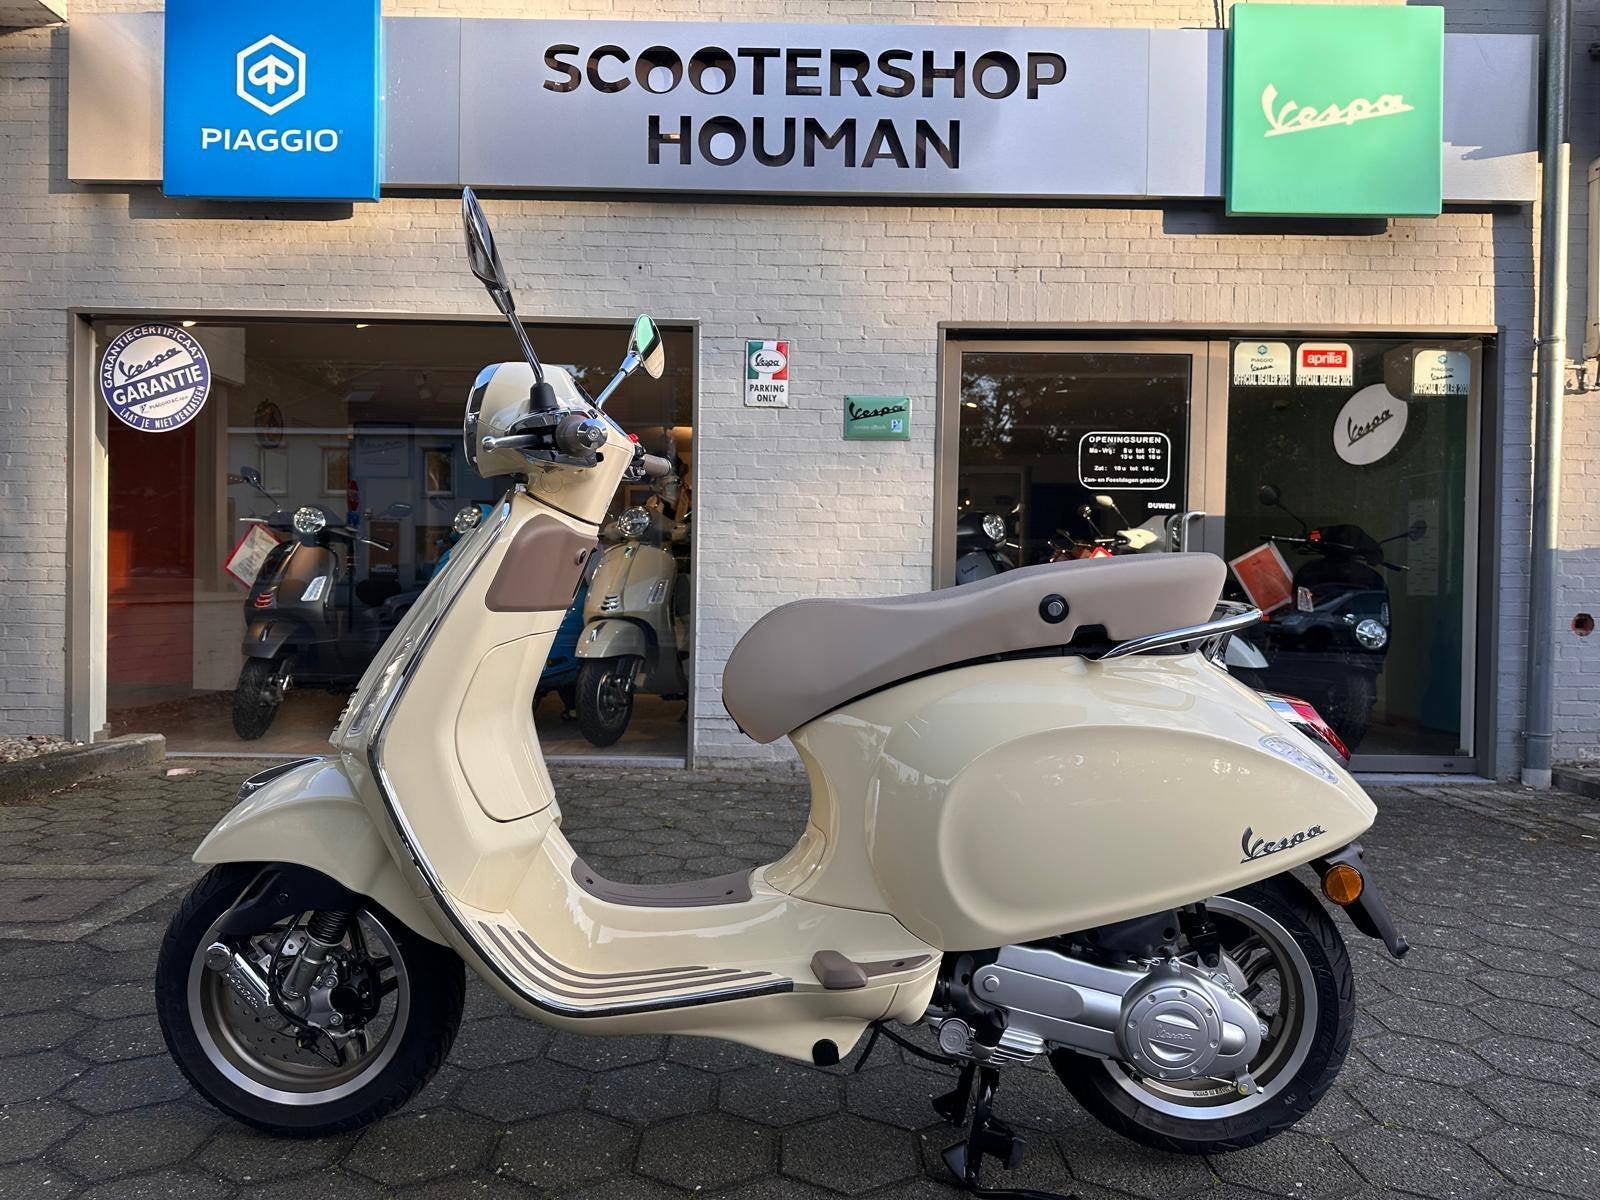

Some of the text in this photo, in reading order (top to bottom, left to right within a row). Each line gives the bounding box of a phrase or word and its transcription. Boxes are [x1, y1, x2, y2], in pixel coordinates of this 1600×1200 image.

[543, 44, 1067, 99] SCOOTERSHOP
[1261, 83, 1415, 137] Vespa
[201, 128, 339, 152] PIAGGIO
[648, 114, 961, 169] HOUMAN
[104, 326, 203, 388] GARANTIECERTIFICAAT
[118, 347, 182, 382] Vespa
[754, 352, 780, 367] Vespa
[1307, 352, 1343, 365] aprilia
[112, 364, 204, 405] GARANTIE
[749, 384, 785, 393] PARKING
[756, 394, 777, 402] ONLY
[119, 386, 206, 429] LAAT JE NIET VERRASSEN
[848, 401, 907, 421] Vespa
[1088, 436, 1162, 444] OPENINGSUREN
[1347, 409, 1393, 447] Vespa
[1147, 502, 1176, 510] DUWEN
[1240, 824, 1327, 864] Vespa
